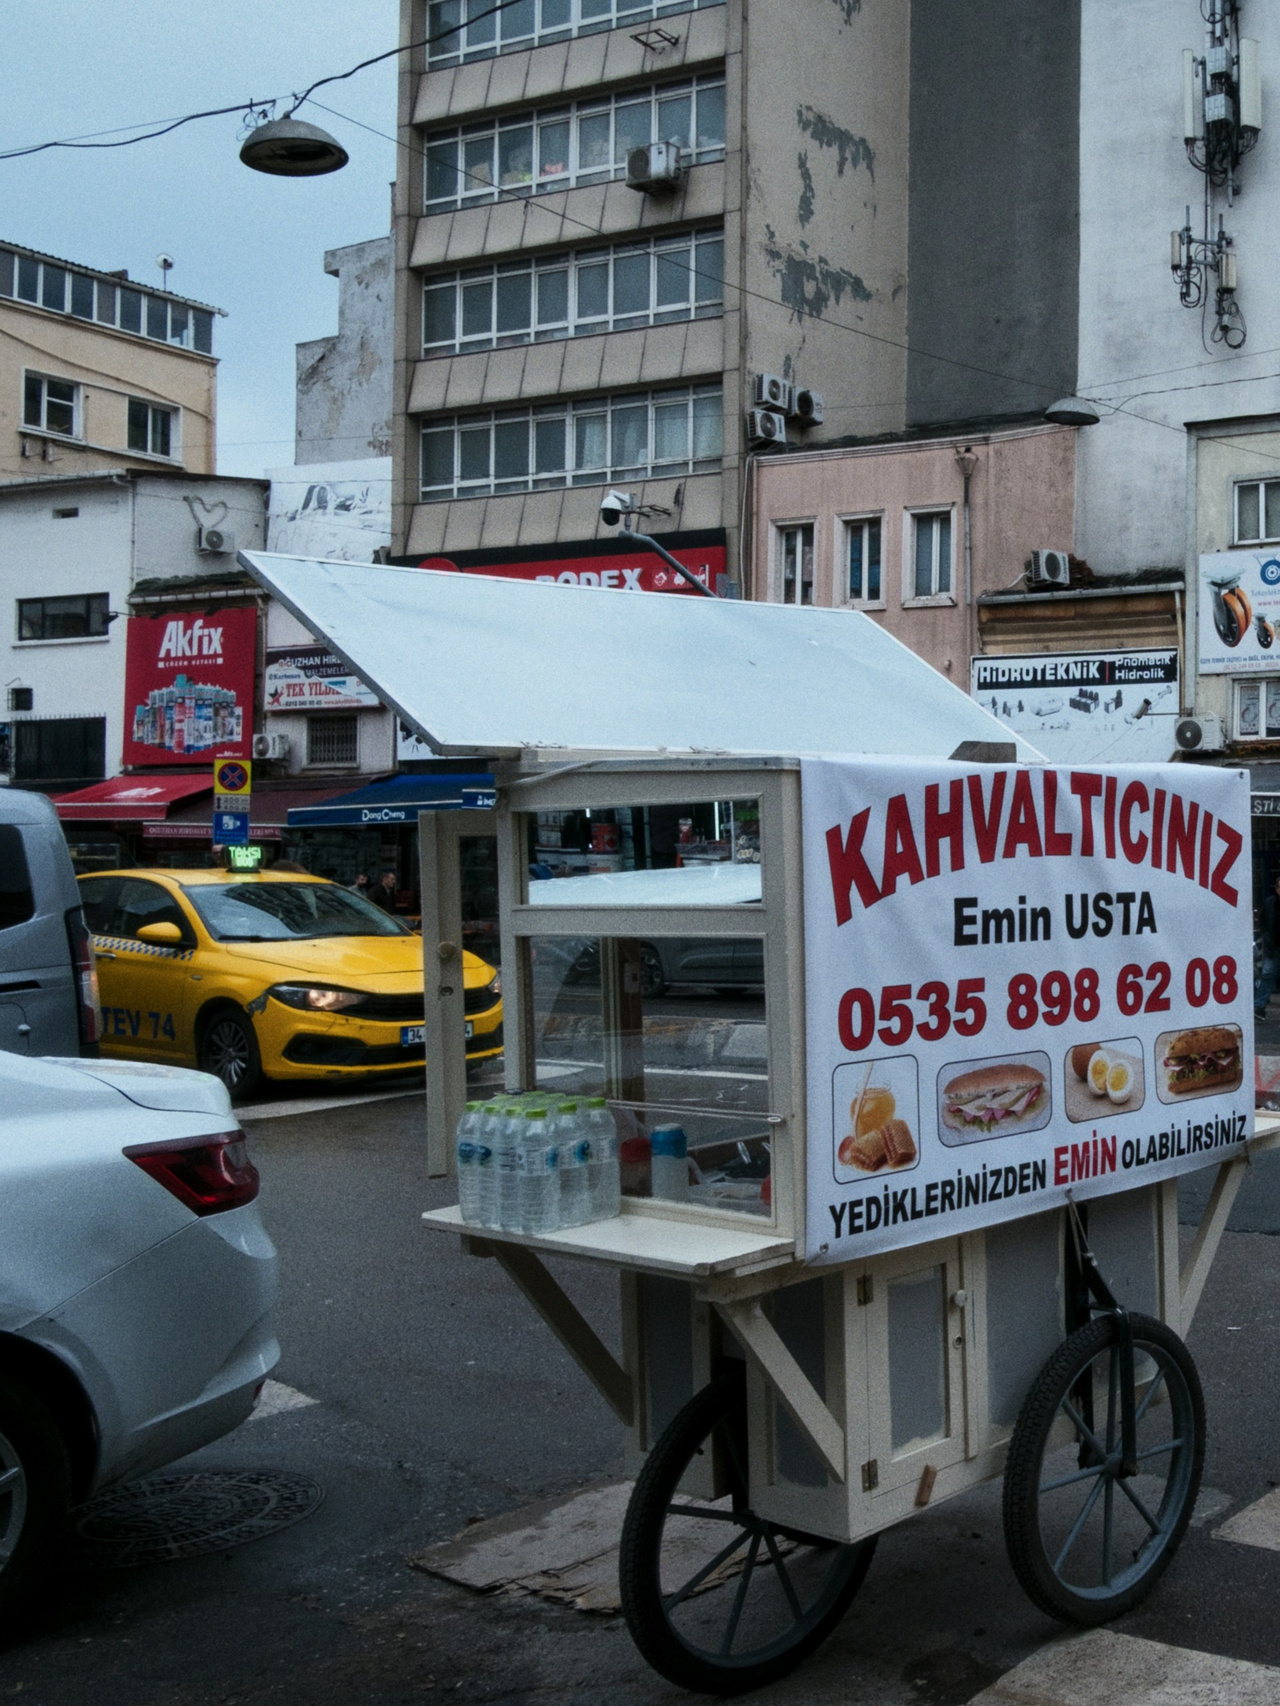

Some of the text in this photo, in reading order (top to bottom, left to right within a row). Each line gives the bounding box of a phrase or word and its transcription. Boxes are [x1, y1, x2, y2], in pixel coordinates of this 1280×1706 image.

[158, 619, 223, 658] Akfix
[279, 656, 321, 668] OĞUZHAN
[1115, 668, 1165, 680] Hidrolik
[286, 683, 306, 697] TEK
[1253, 799, 1273, 816] ŞTİ
[228, 846, 262, 859] TAKSI
[825, 769, 1243, 927] KAHVALTICINIZ
[953, 891, 1157, 946] Emin USTA
[837, 955, 1239, 1052] 0535 898 62 08
[148, 1012, 176, 1041] 74
[409, 1028, 423, 1042] 34
[829, 1113, 1247, 1239] YEDİKLERİNİZDEN EMİN OLABİLİRSİNİZ
